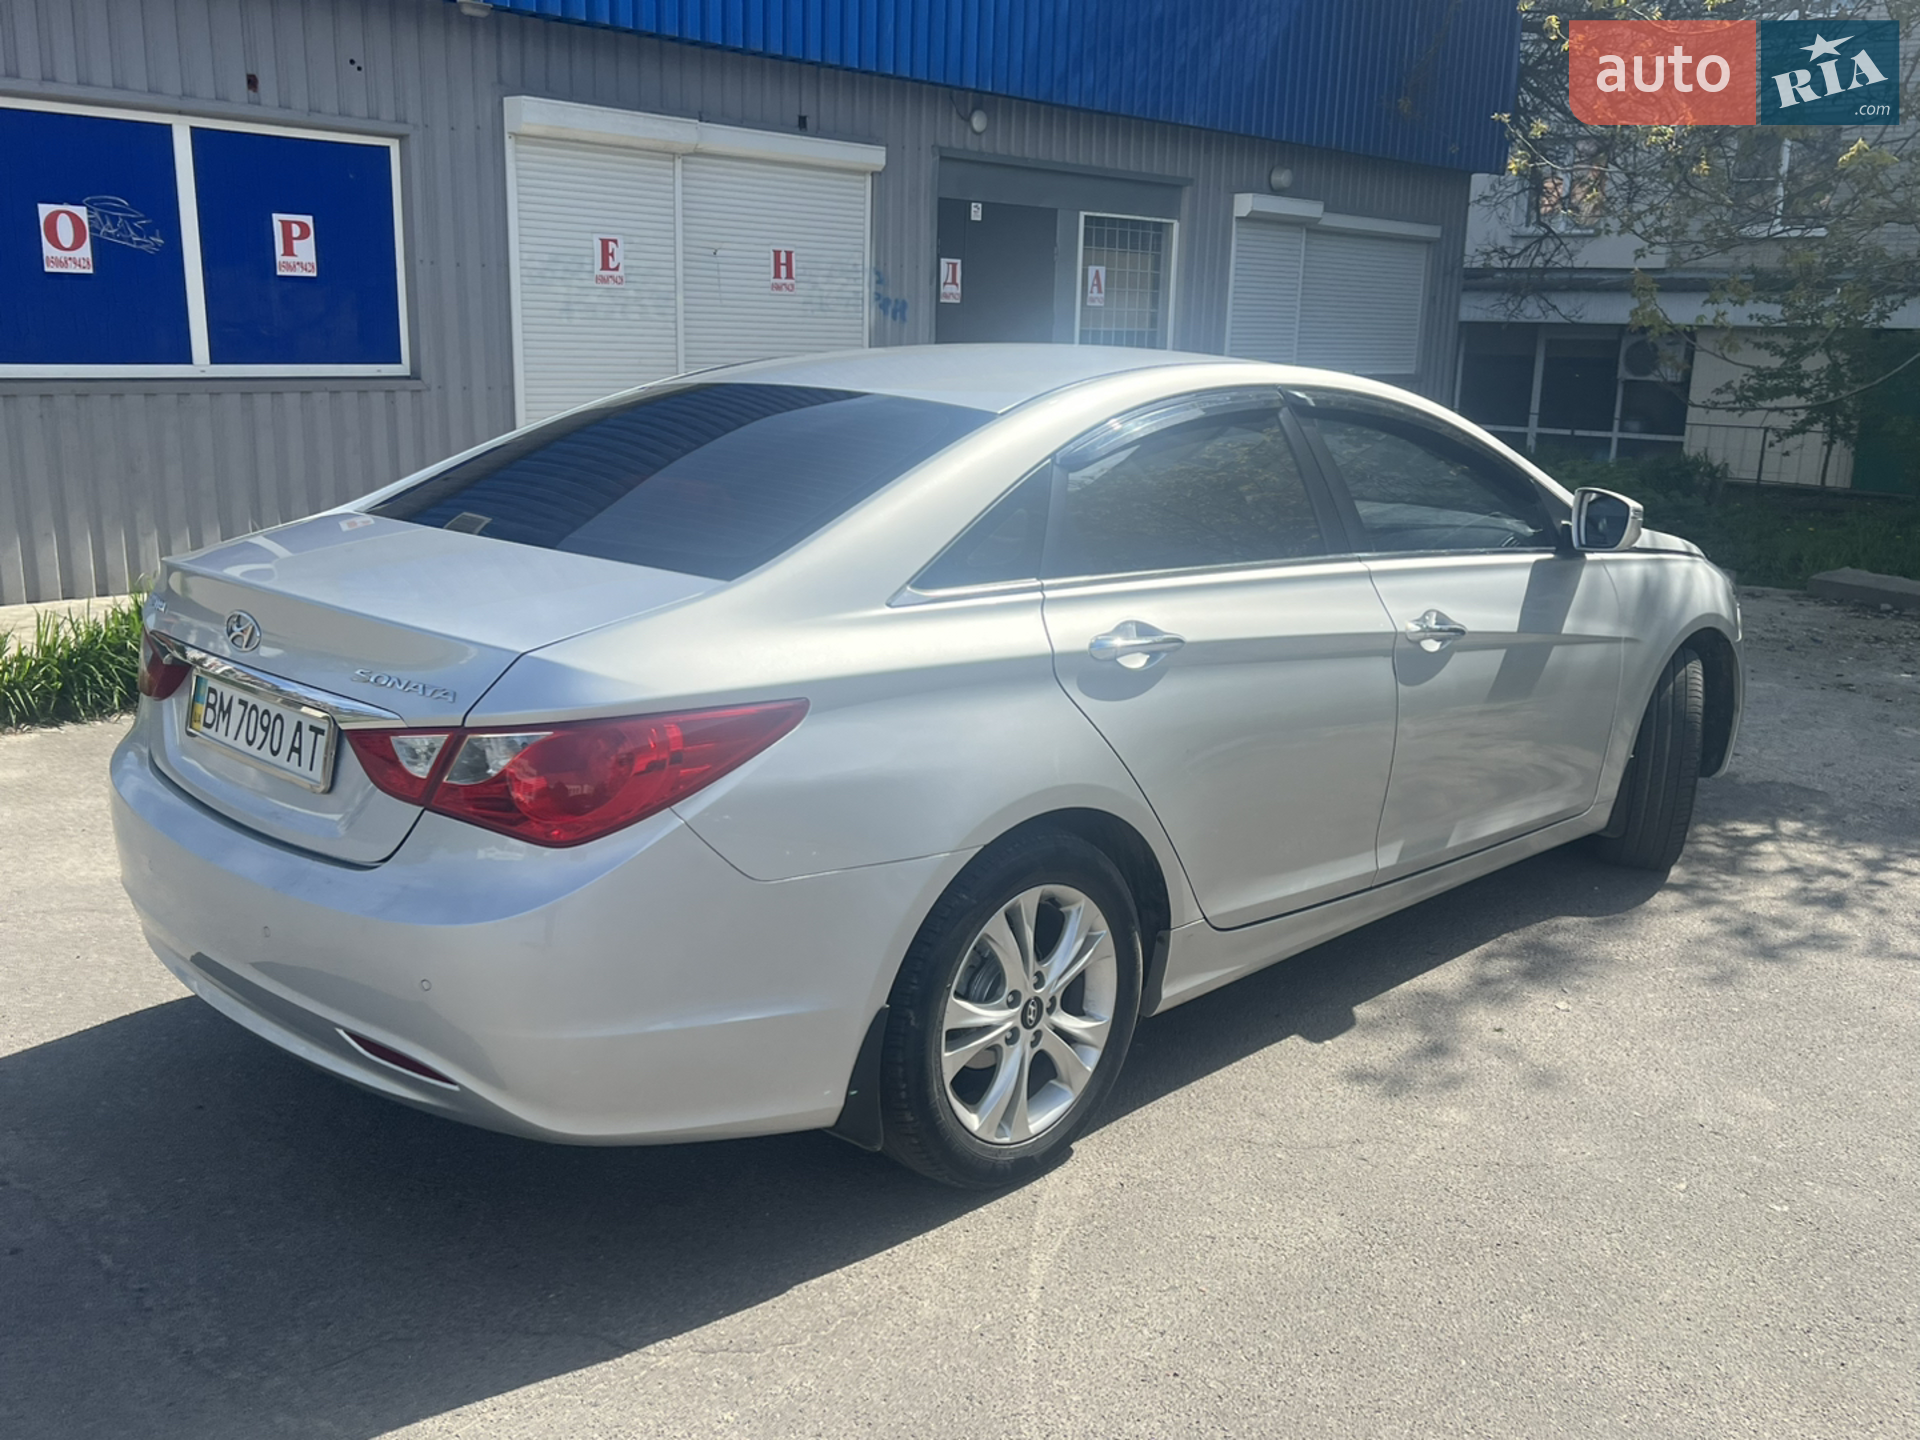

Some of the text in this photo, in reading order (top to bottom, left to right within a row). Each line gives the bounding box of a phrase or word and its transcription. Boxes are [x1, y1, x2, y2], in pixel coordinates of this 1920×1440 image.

[942, 262, 959, 291] Д
[351, 668, 457, 703] SONATA
[202, 686, 325, 772] BM 7090 AT
